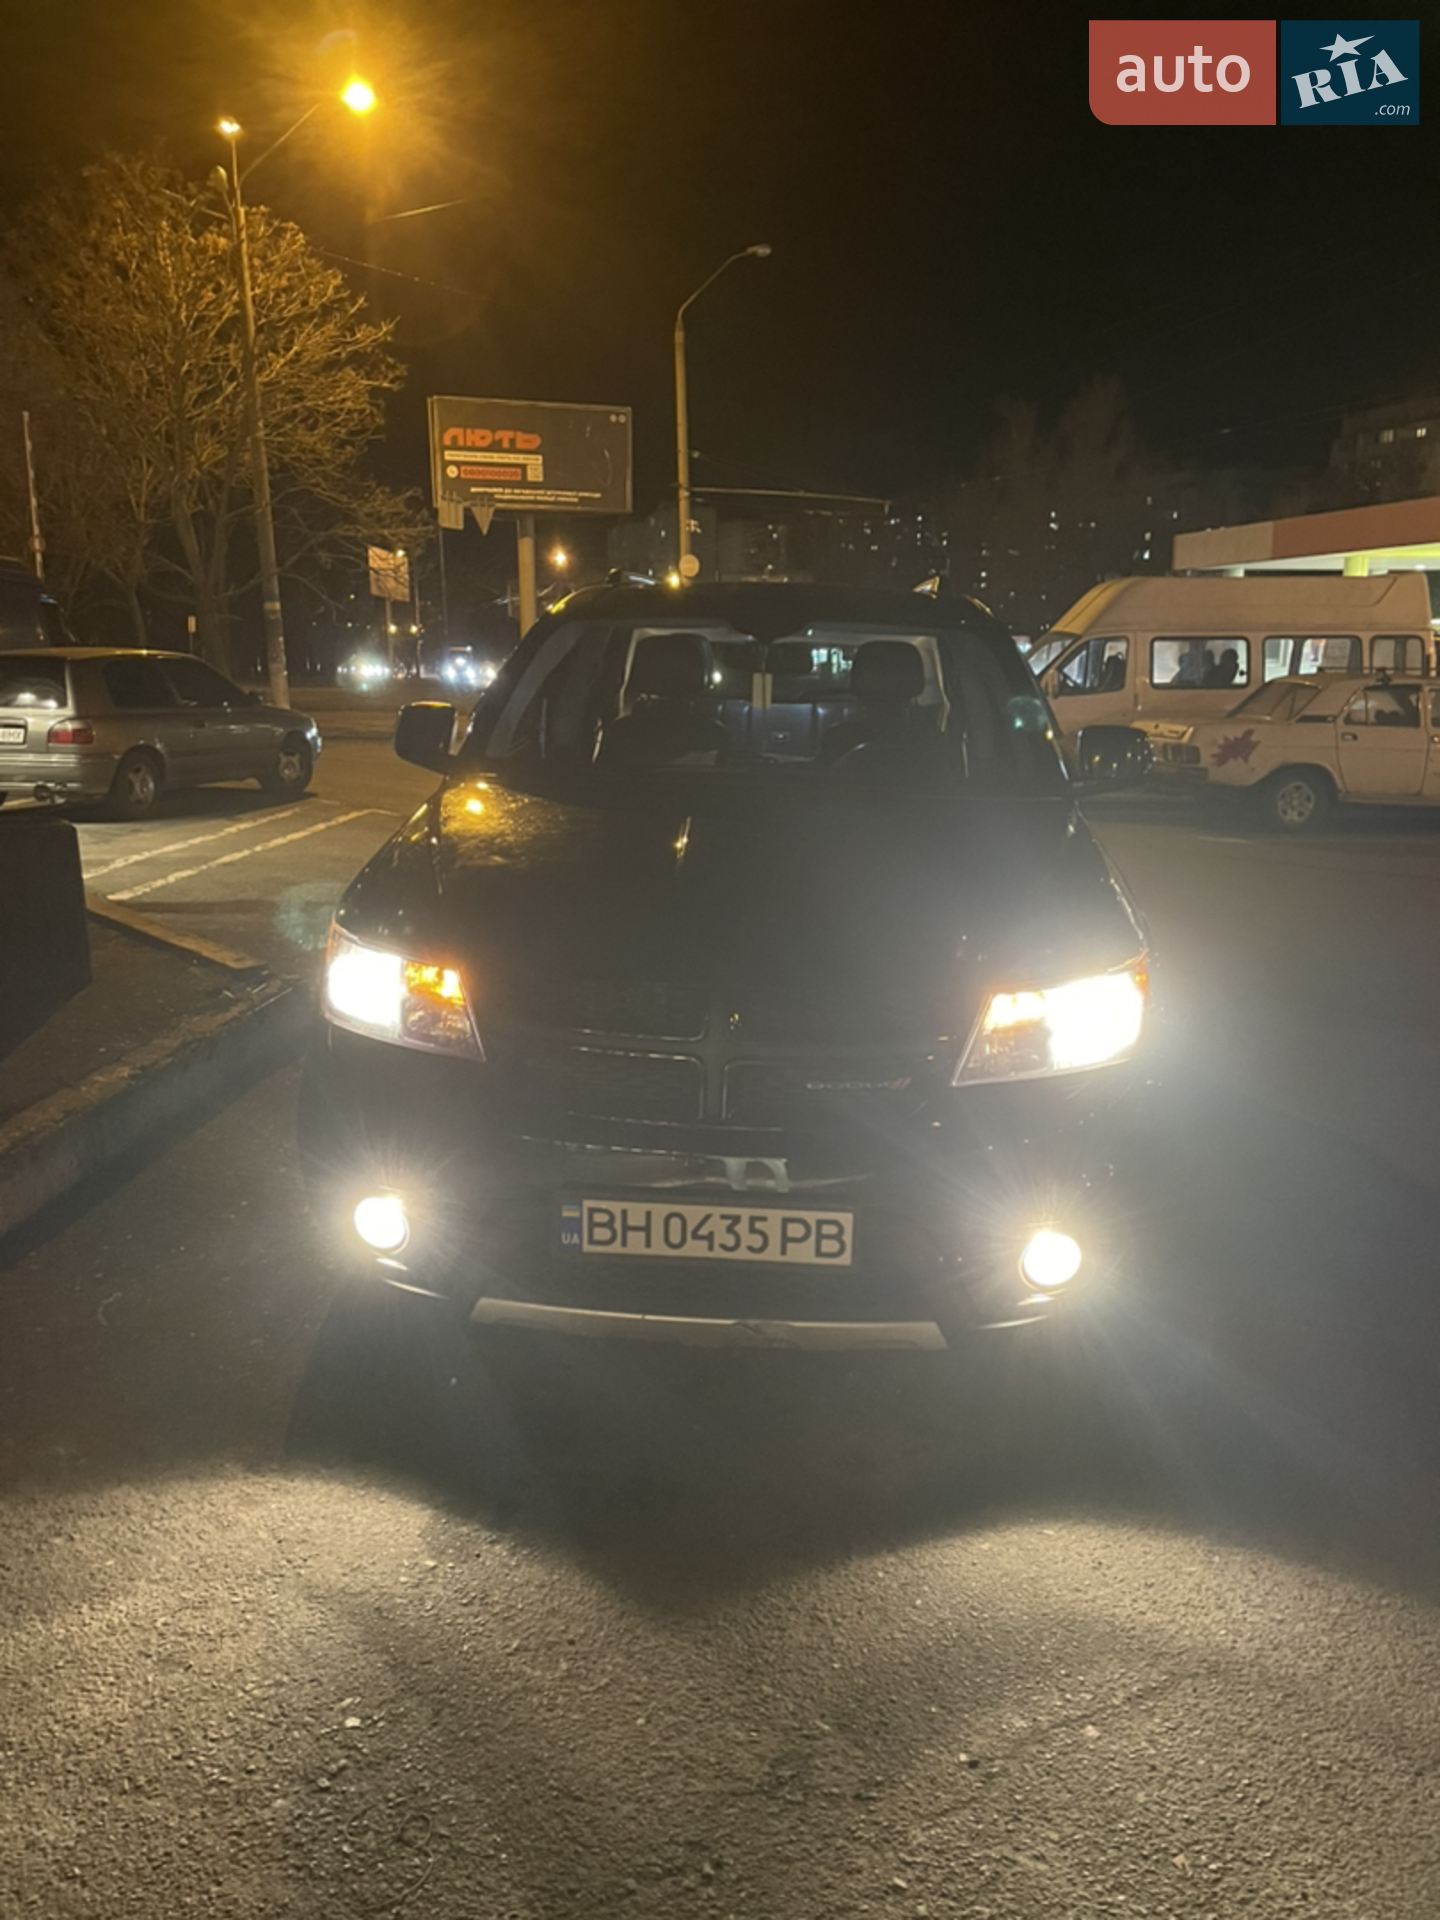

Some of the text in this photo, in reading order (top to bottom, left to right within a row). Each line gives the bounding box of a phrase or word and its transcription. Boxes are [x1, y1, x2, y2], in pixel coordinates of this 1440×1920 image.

[561, 1231, 580, 1245] UA
[587, 1206, 847, 1259] BH 0435 PB
